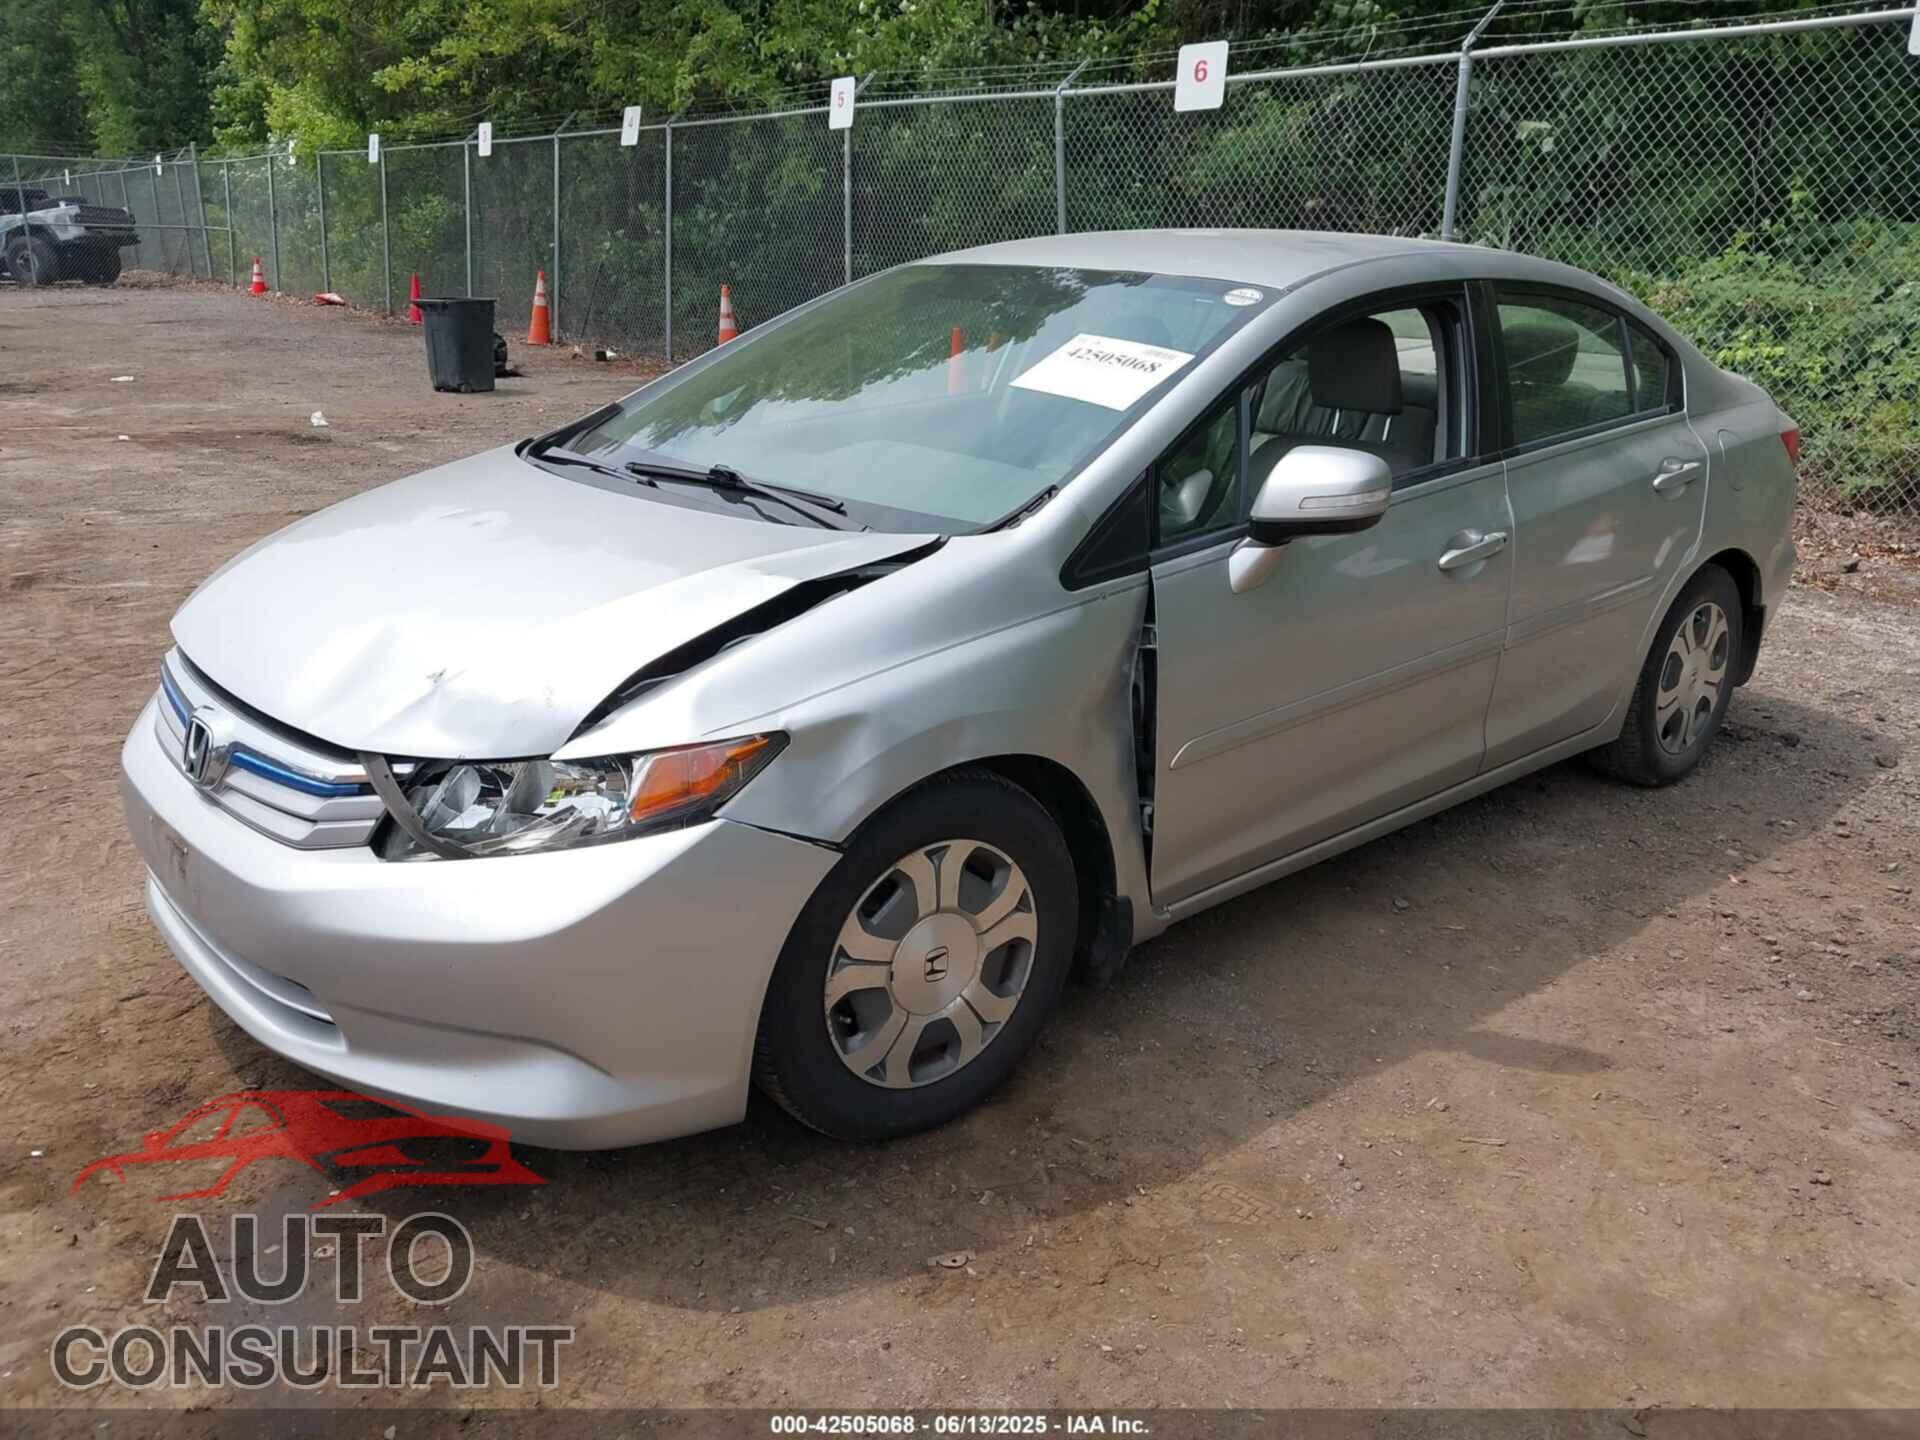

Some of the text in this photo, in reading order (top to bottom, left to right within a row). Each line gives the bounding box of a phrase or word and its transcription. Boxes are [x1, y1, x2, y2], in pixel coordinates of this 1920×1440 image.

[1194, 60, 1208, 82] 6
[836, 91, 845, 108] 5
[1068, 347, 1163, 373] 42505068
